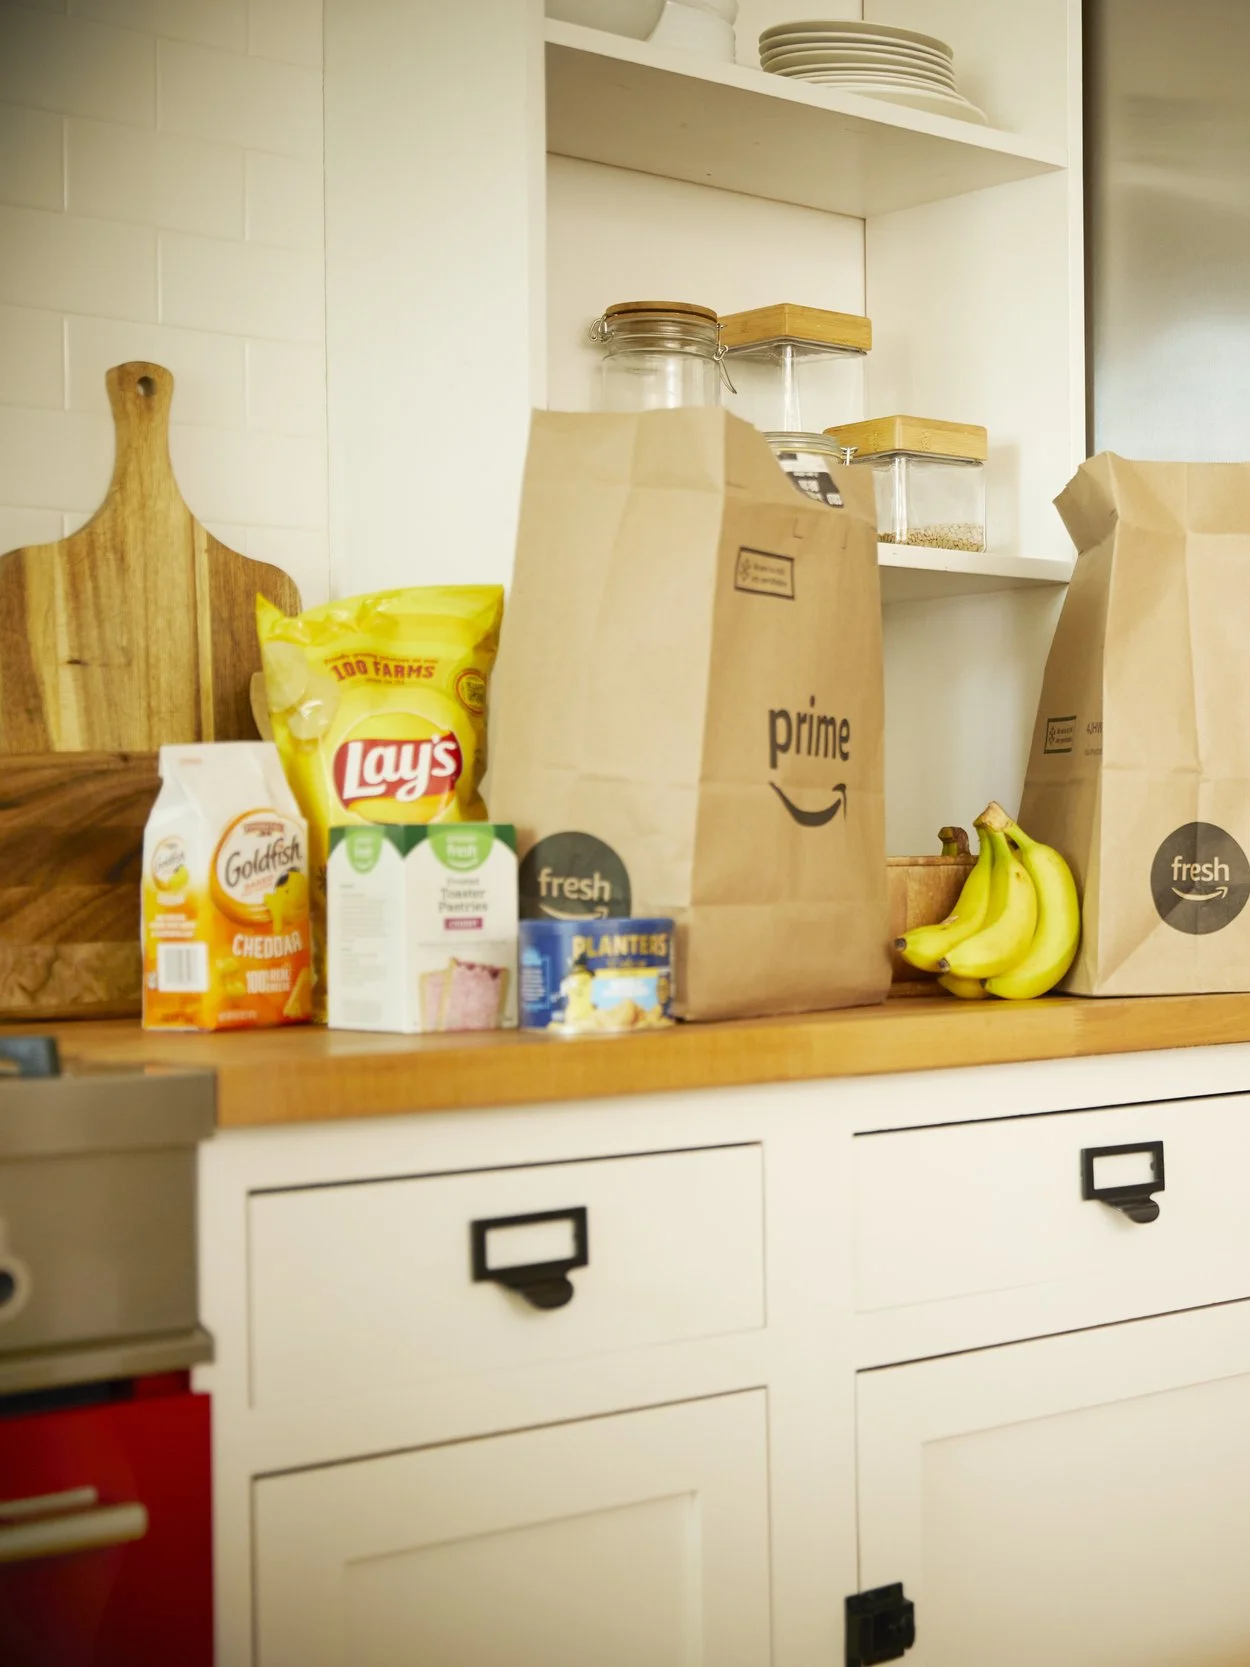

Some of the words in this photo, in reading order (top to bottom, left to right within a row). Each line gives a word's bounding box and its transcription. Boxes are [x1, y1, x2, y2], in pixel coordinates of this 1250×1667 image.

[331, 660, 368, 680] 100
[373, 660, 435, 679] FARMS
[768, 695, 850, 770] prime
[342, 735, 458, 803] Lay's
[225, 835, 302, 888] Goldfish
[1171, 855, 1230, 881] fresh
[440, 888, 485, 899] Toaster
[538, 867, 611, 902] fresh
[438, 901, 488, 914] Pastries
[232, 930, 302, 959] CHEDDAR
[572, 933, 669, 960] PLANTERS
